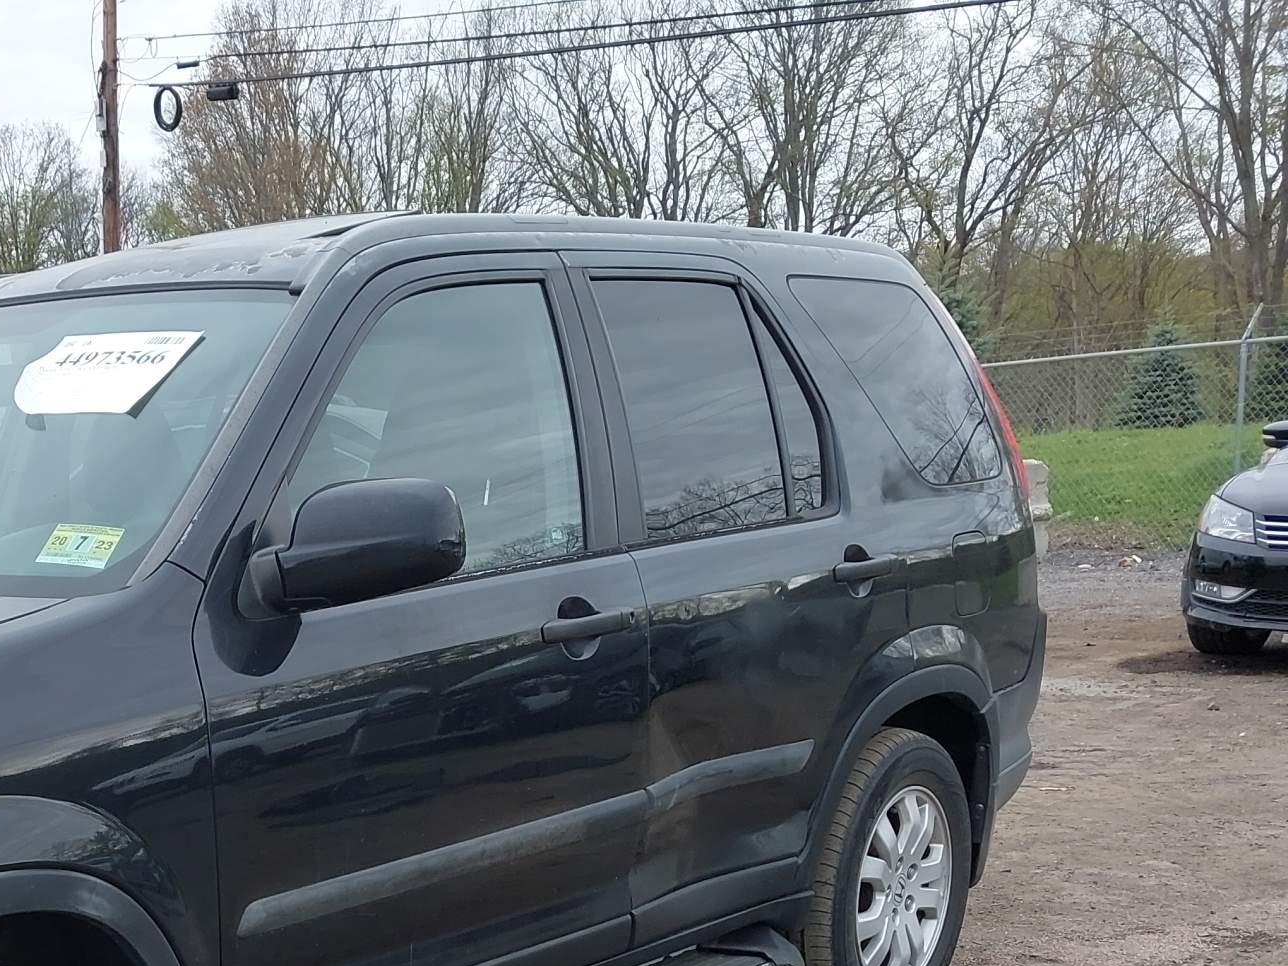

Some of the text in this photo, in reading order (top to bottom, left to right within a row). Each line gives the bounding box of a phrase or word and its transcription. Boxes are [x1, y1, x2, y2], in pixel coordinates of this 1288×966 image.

[55, 350, 170, 367] 44973566
[51, 535, 114, 551] 20 7 23
